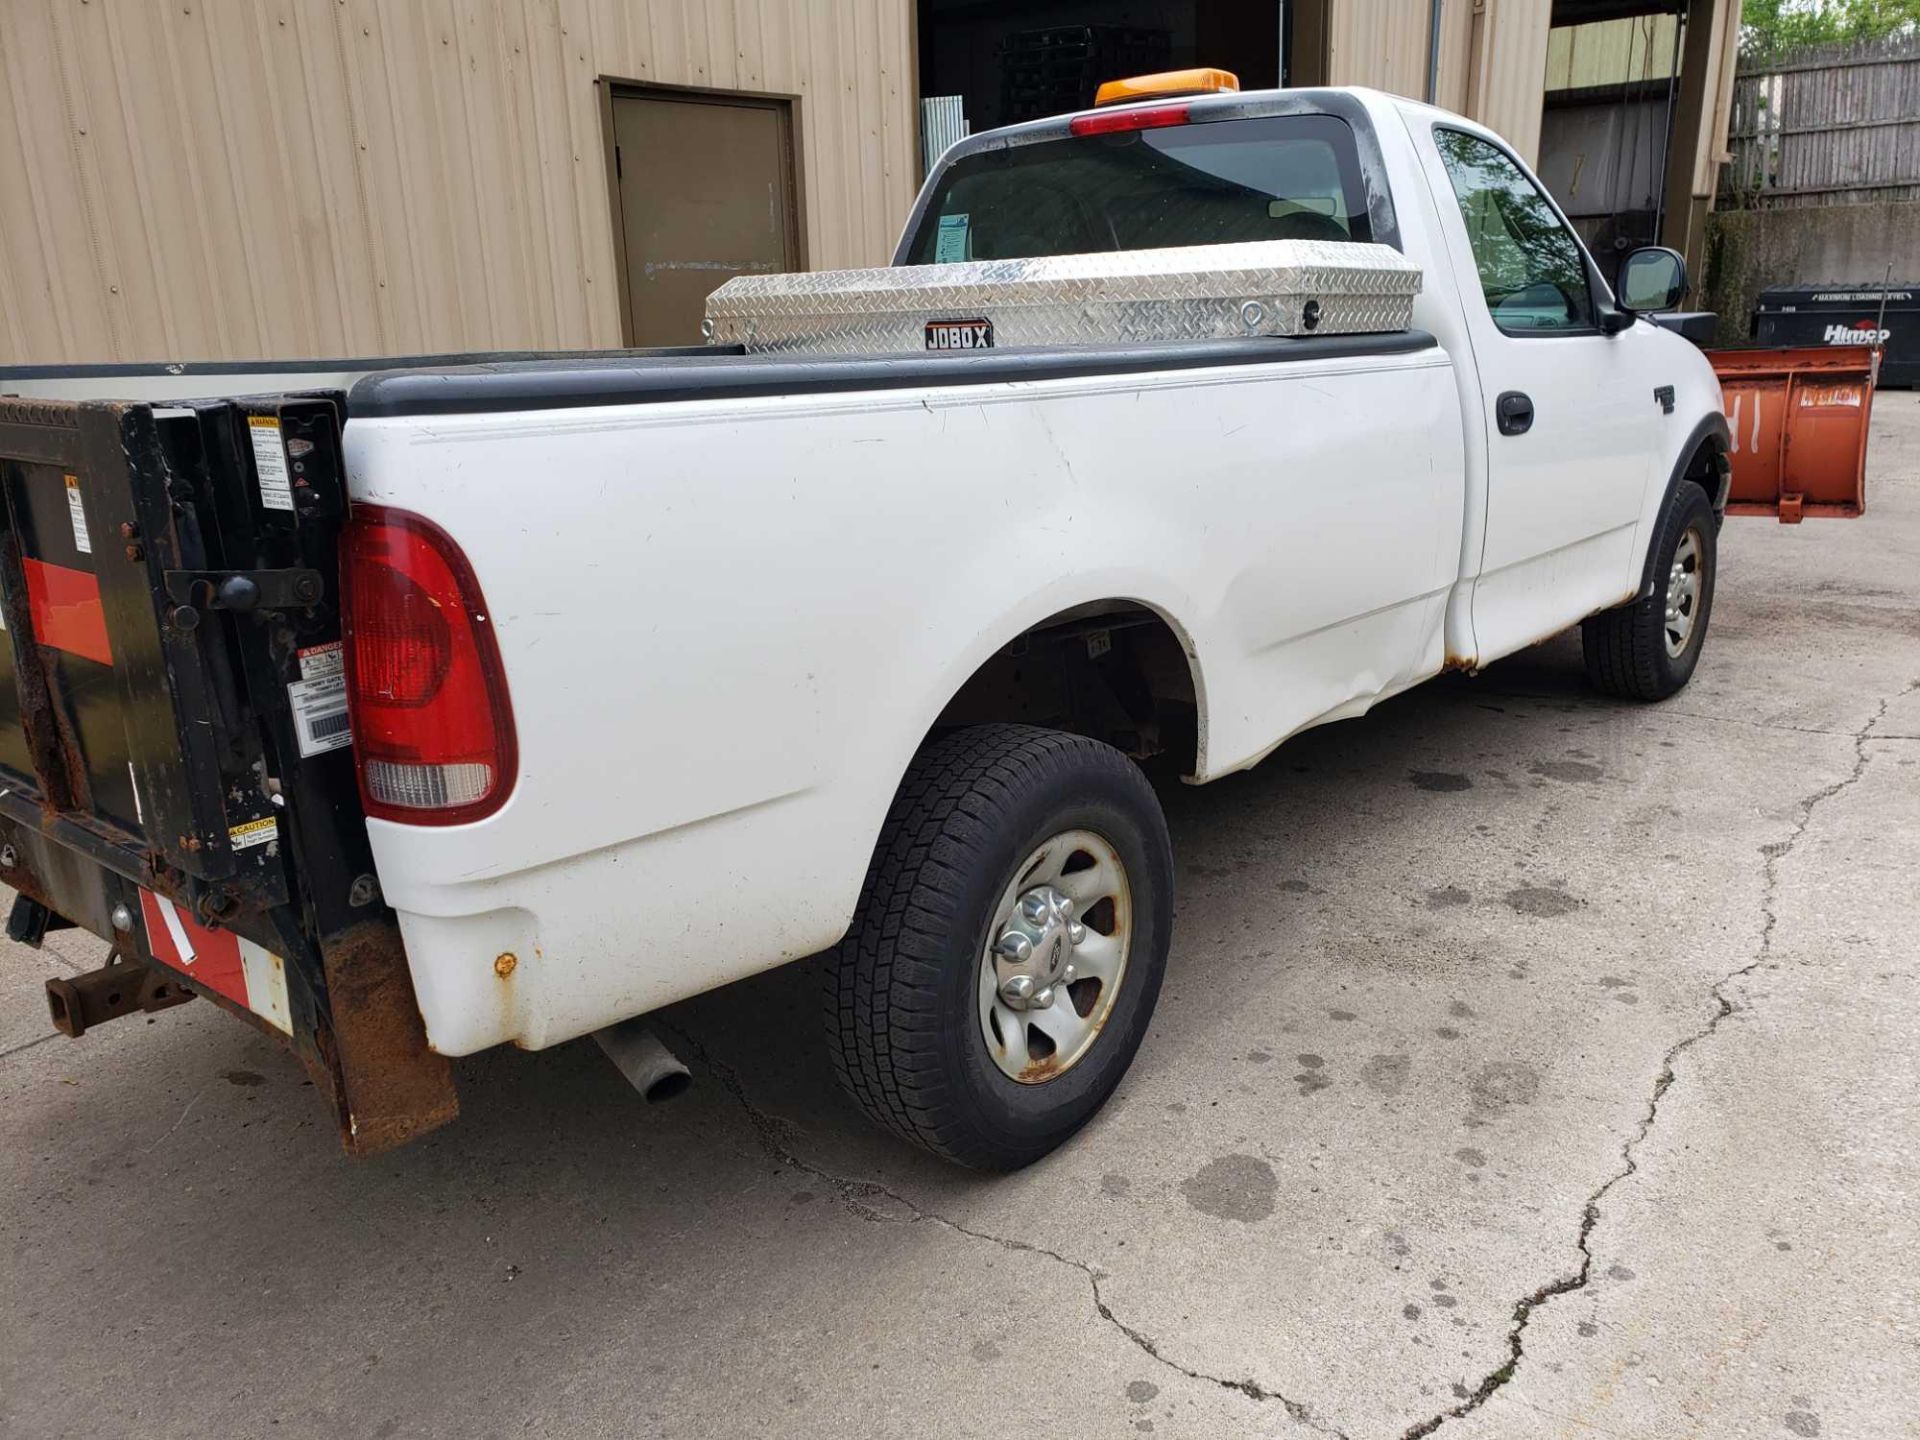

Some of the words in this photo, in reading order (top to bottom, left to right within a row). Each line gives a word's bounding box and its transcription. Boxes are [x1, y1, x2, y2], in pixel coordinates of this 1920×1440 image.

[1818, 293, 1850, 301] MAXIMUM
[1852, 293, 1882, 301] LOADING
[1884, 292, 1905, 300] EVEL
[928, 326, 988, 349] JOBOX
[1824, 324, 1891, 342] Himco
[237, 819, 275, 834] CAUTION
